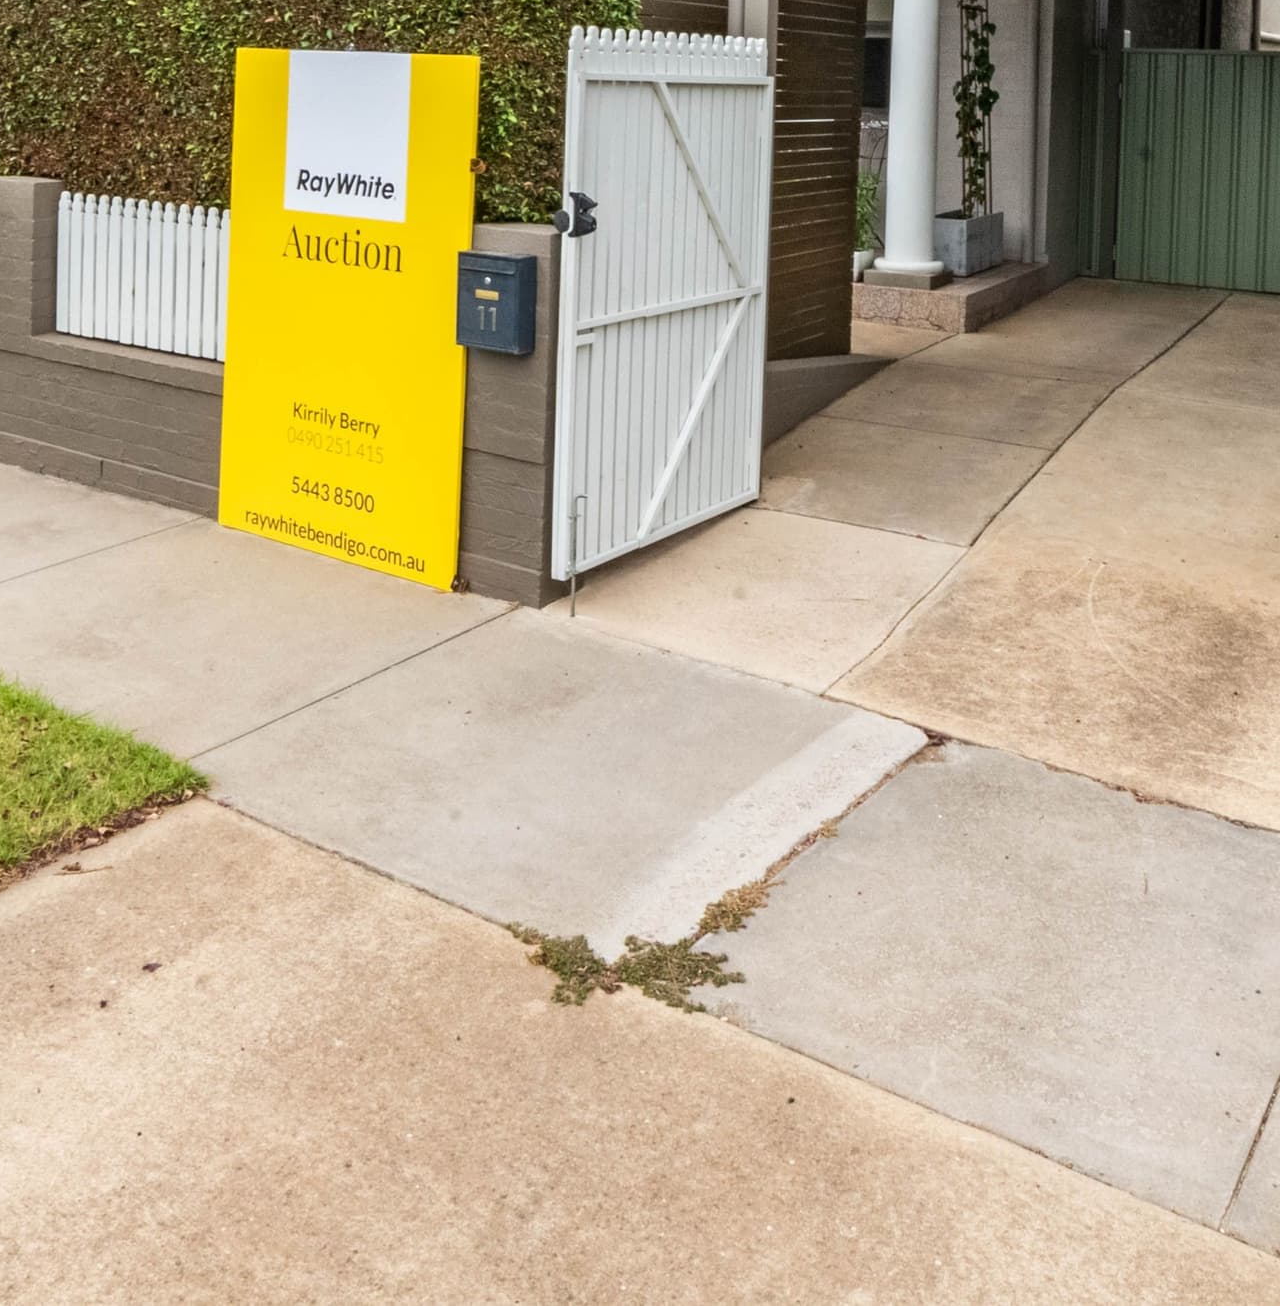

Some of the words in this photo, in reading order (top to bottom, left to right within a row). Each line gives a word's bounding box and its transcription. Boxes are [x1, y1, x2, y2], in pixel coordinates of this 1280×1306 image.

[282, 224, 403, 273] Auction
[477, 305, 497, 332] 11
[293, 402, 336, 429] Kirrily
[340, 412, 380, 439] Berry
[287, 426, 322, 450] 0490
[326, 435, 352, 457] 251
[356, 443, 384, 464] 415
[291, 476, 330, 502] 5443
[334, 487, 375, 514] 8500
[245, 510, 426, 574] raywhitebendigo.com.au
